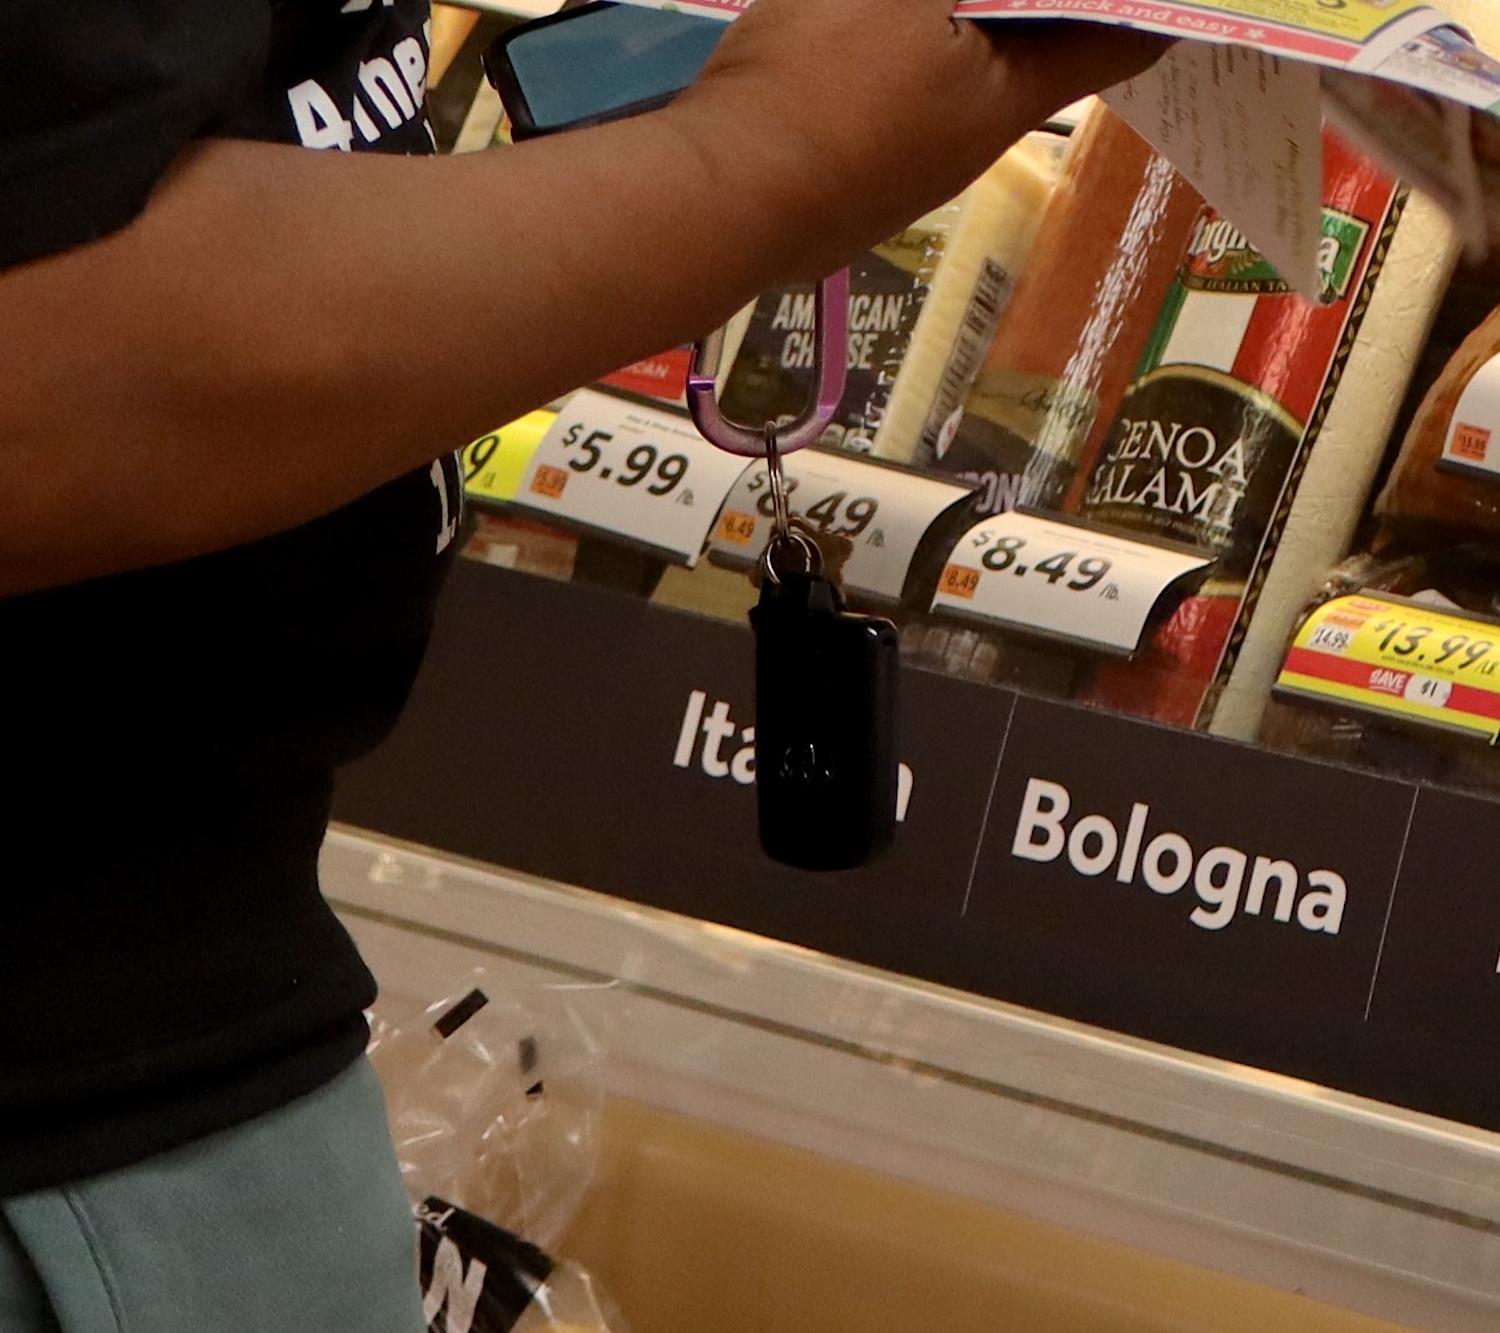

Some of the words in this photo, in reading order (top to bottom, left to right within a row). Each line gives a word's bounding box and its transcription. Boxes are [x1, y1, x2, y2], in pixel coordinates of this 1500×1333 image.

[1117, 3, 1174, 23] and
[1175, 8, 1238, 38] easy
[562, 422, 690, 498] $5.99
[970, 526, 1113, 593] $8.49
[1373, 617, 1496, 671] $13.99
[1368, 669, 1408, 690] SAVE
[1009, 776, 1349, 938] Bologna
